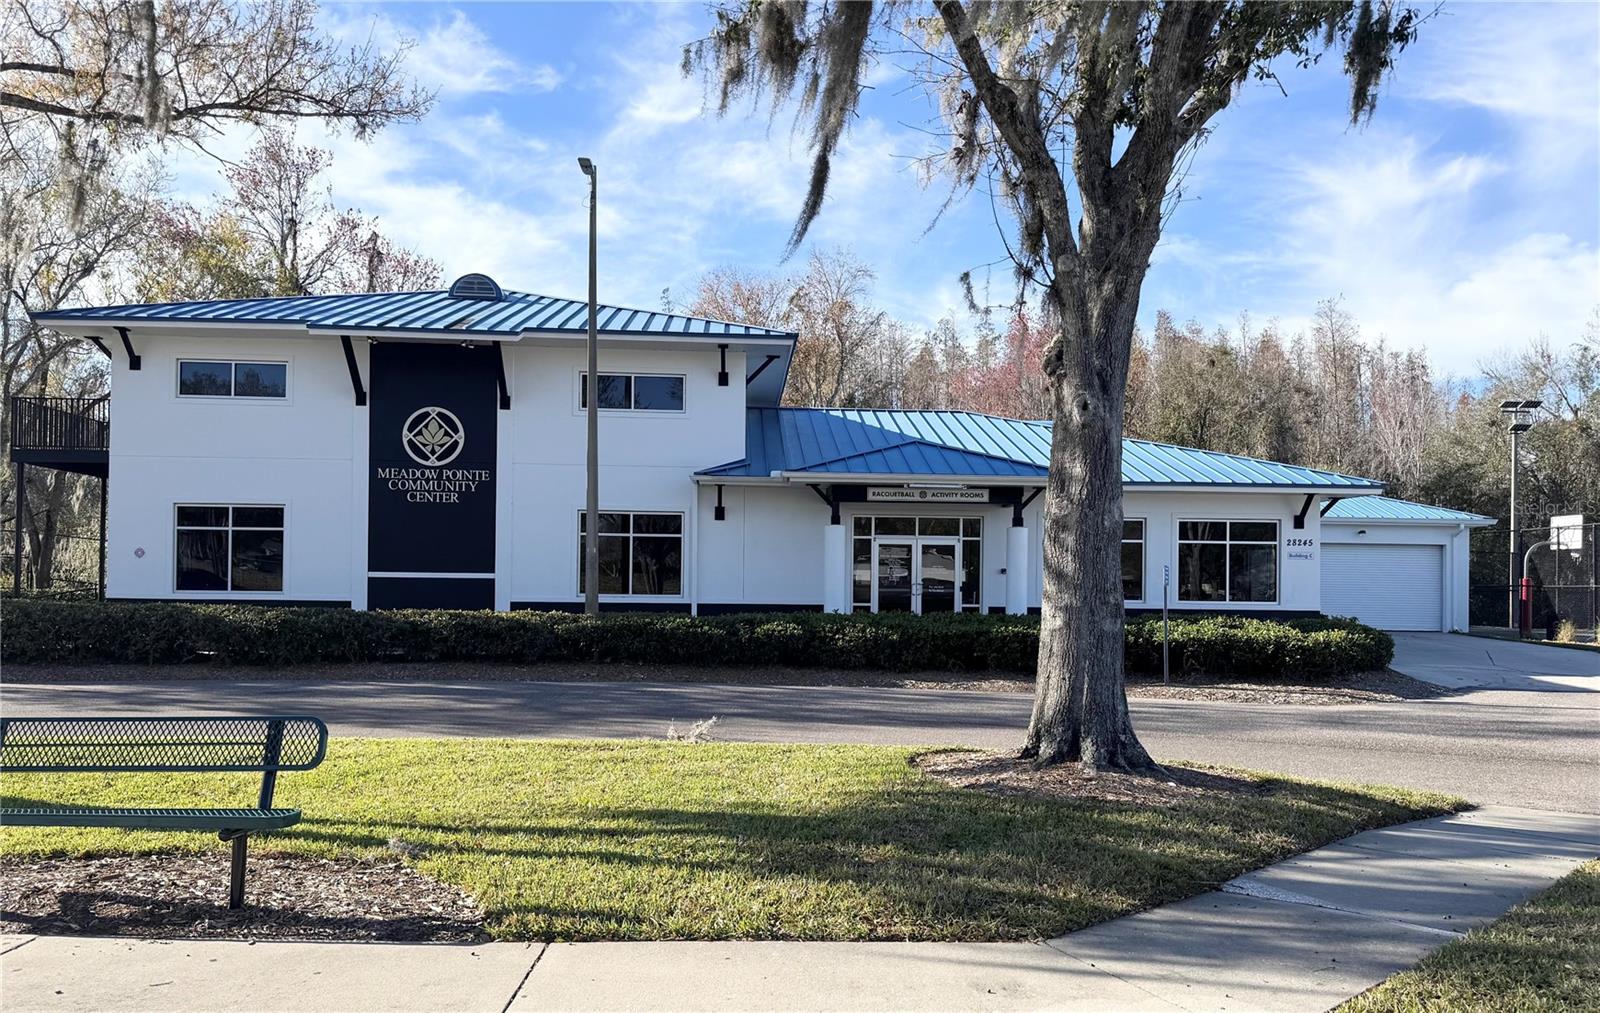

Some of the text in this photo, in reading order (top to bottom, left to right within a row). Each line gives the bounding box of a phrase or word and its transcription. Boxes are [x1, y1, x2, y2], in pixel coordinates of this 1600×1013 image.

[377, 468, 490, 481] MEADOW POINTE
[388, 479, 479, 492] COMMUNITY
[406, 491, 459, 503] CENTER
[1286, 538, 1313, 546] 28245
